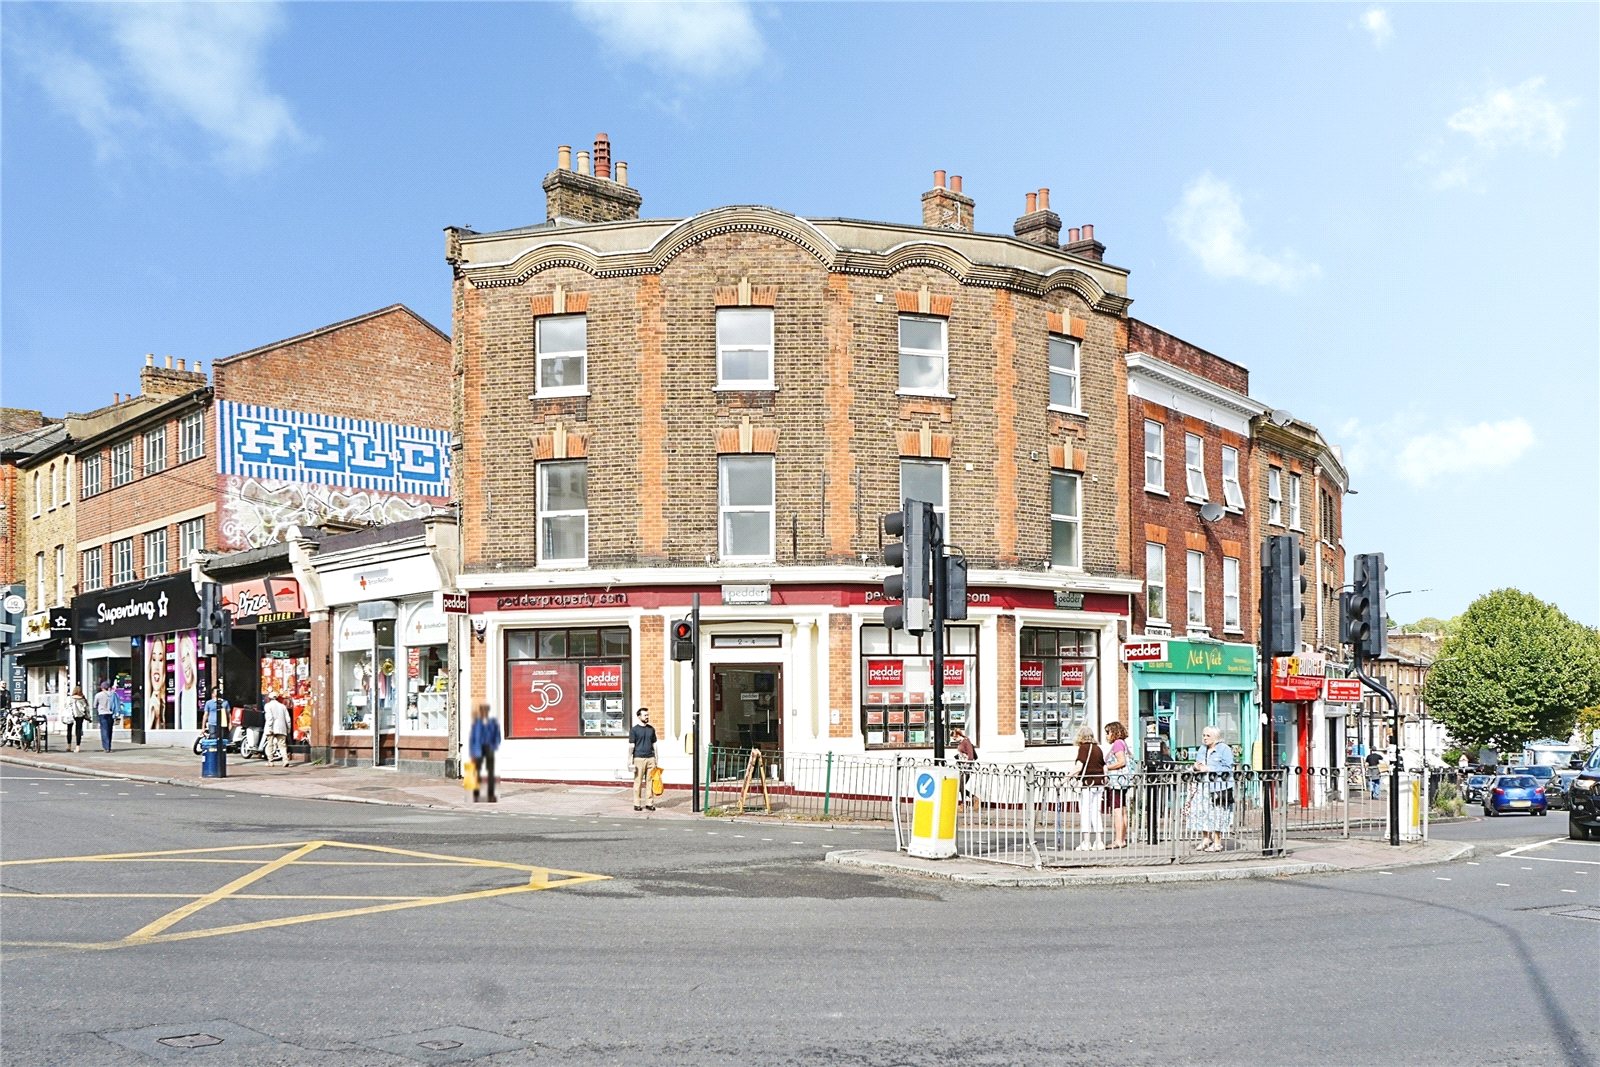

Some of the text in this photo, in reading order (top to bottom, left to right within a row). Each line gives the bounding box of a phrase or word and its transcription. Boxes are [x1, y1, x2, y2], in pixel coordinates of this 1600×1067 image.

[238, 419, 449, 480] HELC
[444, 593, 466, 611] pedder
[497, 592, 628, 610] pedderproperty.com
[728, 587, 765, 601] pedder
[97, 598, 156, 625] Superdrug
[1124, 643, 1161, 659] pedder
[587, 671, 619, 686] pedder
[870, 665, 902, 680] pedder
[1062, 667, 1083, 680] pedder
